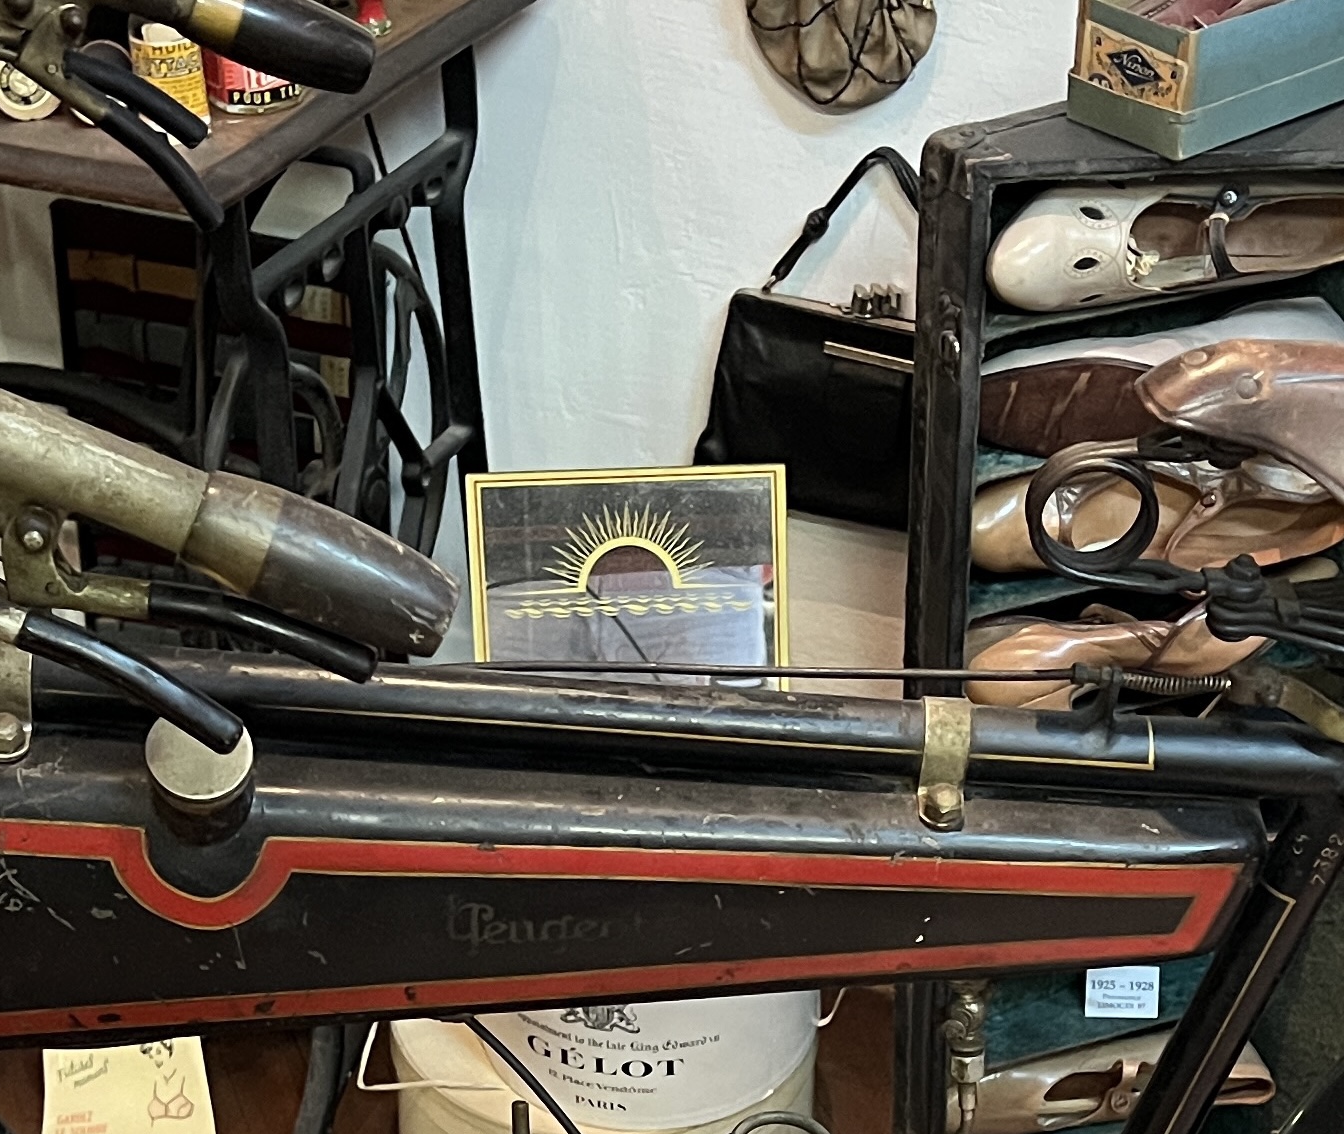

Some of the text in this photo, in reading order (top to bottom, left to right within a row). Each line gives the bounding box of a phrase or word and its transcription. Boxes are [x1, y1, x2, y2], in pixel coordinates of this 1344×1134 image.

[233, 91, 272, 104] POUR
[1090, 979, 1116, 990] 1925
[1129, 981, 1155, 991] 1928
[574, 1034, 585, 1045] to
[587, 1037, 604, 1050] the
[606, 1040, 626, 1051] late
[661, 1036, 707, 1051] Edward
[562, 1073, 596, 1090] Place
[575, 1095, 627, 1111] PARIS
